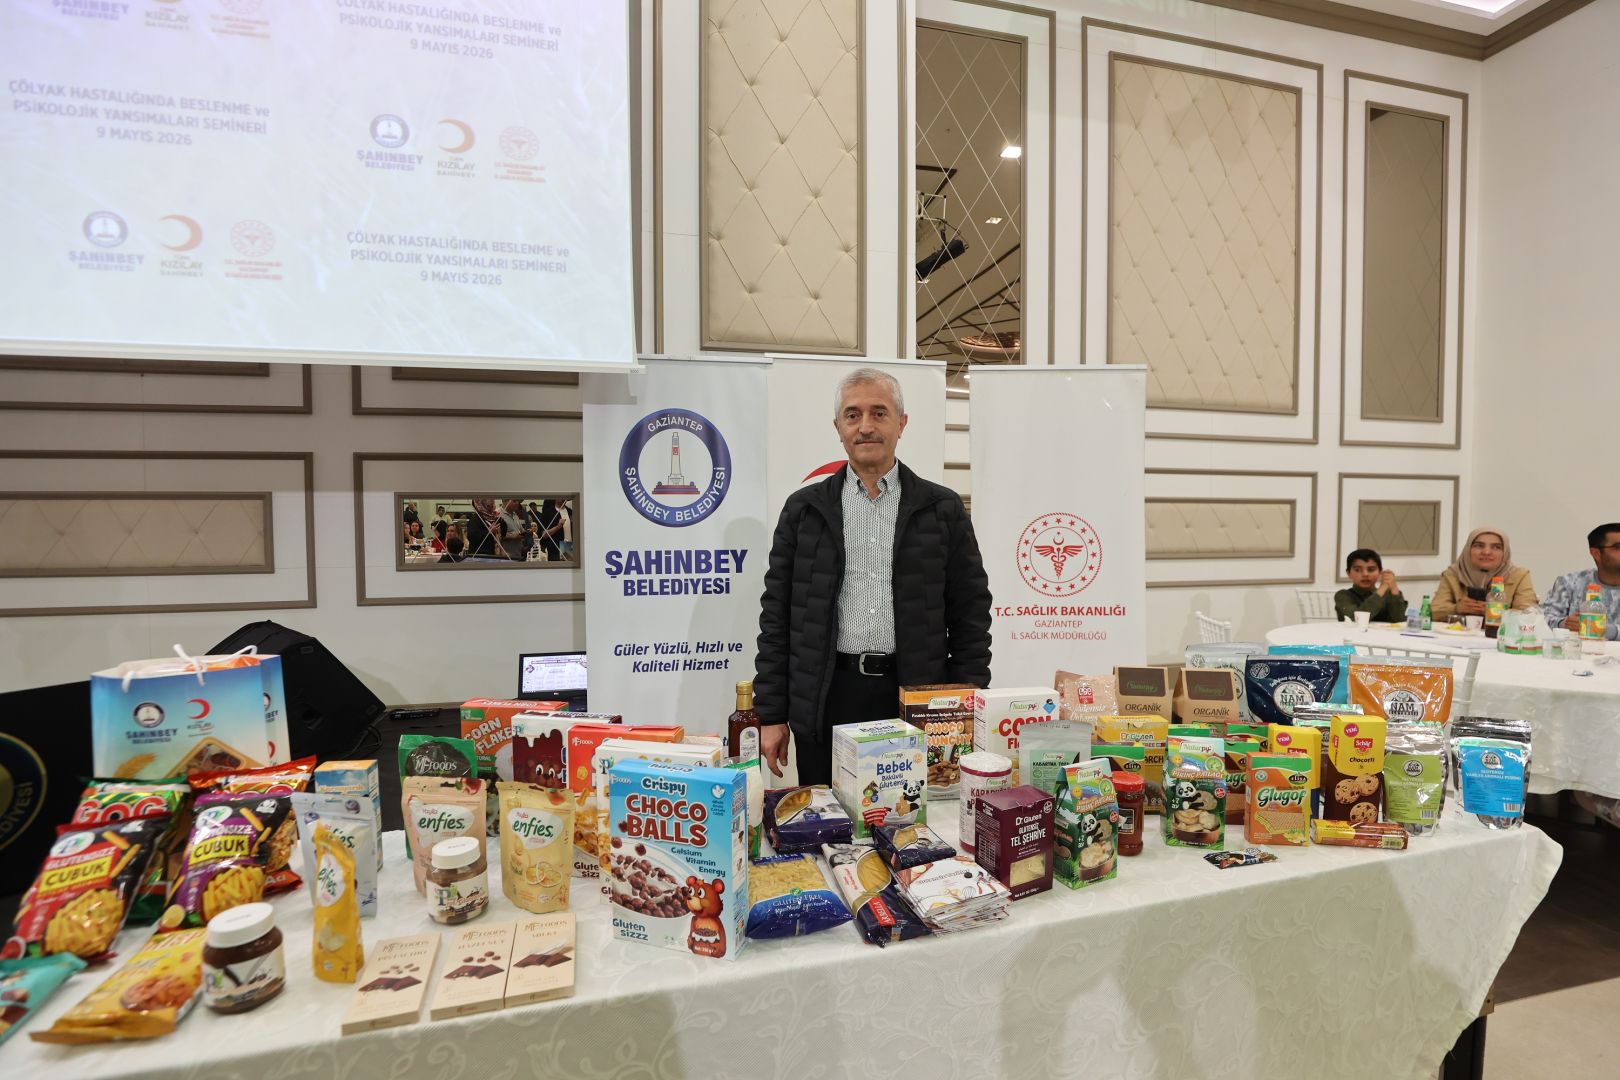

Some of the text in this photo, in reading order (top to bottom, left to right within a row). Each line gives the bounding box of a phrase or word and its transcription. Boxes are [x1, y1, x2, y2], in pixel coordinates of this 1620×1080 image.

[388, 1, 480, 25] HASTALIĞINDA
[483, 15, 545, 34] BESLENME
[548, 25, 562, 36] ve
[339, 12, 559, 51] PSİKOLOJİK YANSIMALARI SEMİNERİ
[410, 38, 494, 60] 9 MAYIS 2026
[9, 79, 270, 117] ÇÖLYAK HASTALIĞINDA BESLENME ve
[13, 99, 268, 135] PSİKOLOJİK YANSIMALARI SEMİNERİ
[96, 127, 192, 146] 9 MAYIS 2026
[347, 231, 570, 257] ÇÖLYAK HASTALIĞINDA BESLENME ve
[351, 248, 567, 273] PSİKOLOJİK YANSIMALARI SEMİNERİ
[420, 271, 503, 286] 9 MAYIS 2026
[647, 414, 703, 433] GAZİANTEP
[624, 466, 726, 521] ŞAHİNBEY BELEDİYESİ
[605, 549, 748, 579] ŞAHİNBEY
[623, 577, 730, 597] BELEDİYESİ
[995, 604, 1126, 617] T.C. SAĞLIK BAKANLIĞI
[1034, 619, 1083, 629] GAZİANTEP
[1011, 630, 1107, 641] İL SAĞLIK MÜDÜRLÜĞÜ
[614, 640, 743, 657] Güler Yüzlü, Hızlı ve
[632, 657, 730, 674] Kaliteli Hizmet
[1281, 695, 1304, 703] NAM
[1391, 702, 1414, 711] NAM
[925, 721, 964, 735] CHOCO
[476, 726, 512, 755] FLAKE
[927, 733, 972, 747] RUNCHY
[1184, 744, 1211, 754] Naturpy
[877, 759, 912, 775] Bebek
[642, 778, 687, 795] Crispy
[1225, 774, 1246, 787] ugo
[1258, 786, 1307, 807] Glugof
[626, 794, 707, 822] CHOCO
[1024, 814, 1042, 824] Gluten
[627, 815, 707, 847] BALLS
[1011, 829, 1046, 847] TEL ŞEHRİYE
[671, 847, 702, 857] Calsium
[574, 862, 599, 871] Glute
[686, 857, 716, 866] Vitamin
[699, 867, 726, 877] Energy
[613, 918, 646, 932] Gluten
[621, 930, 648, 941] sizzz
